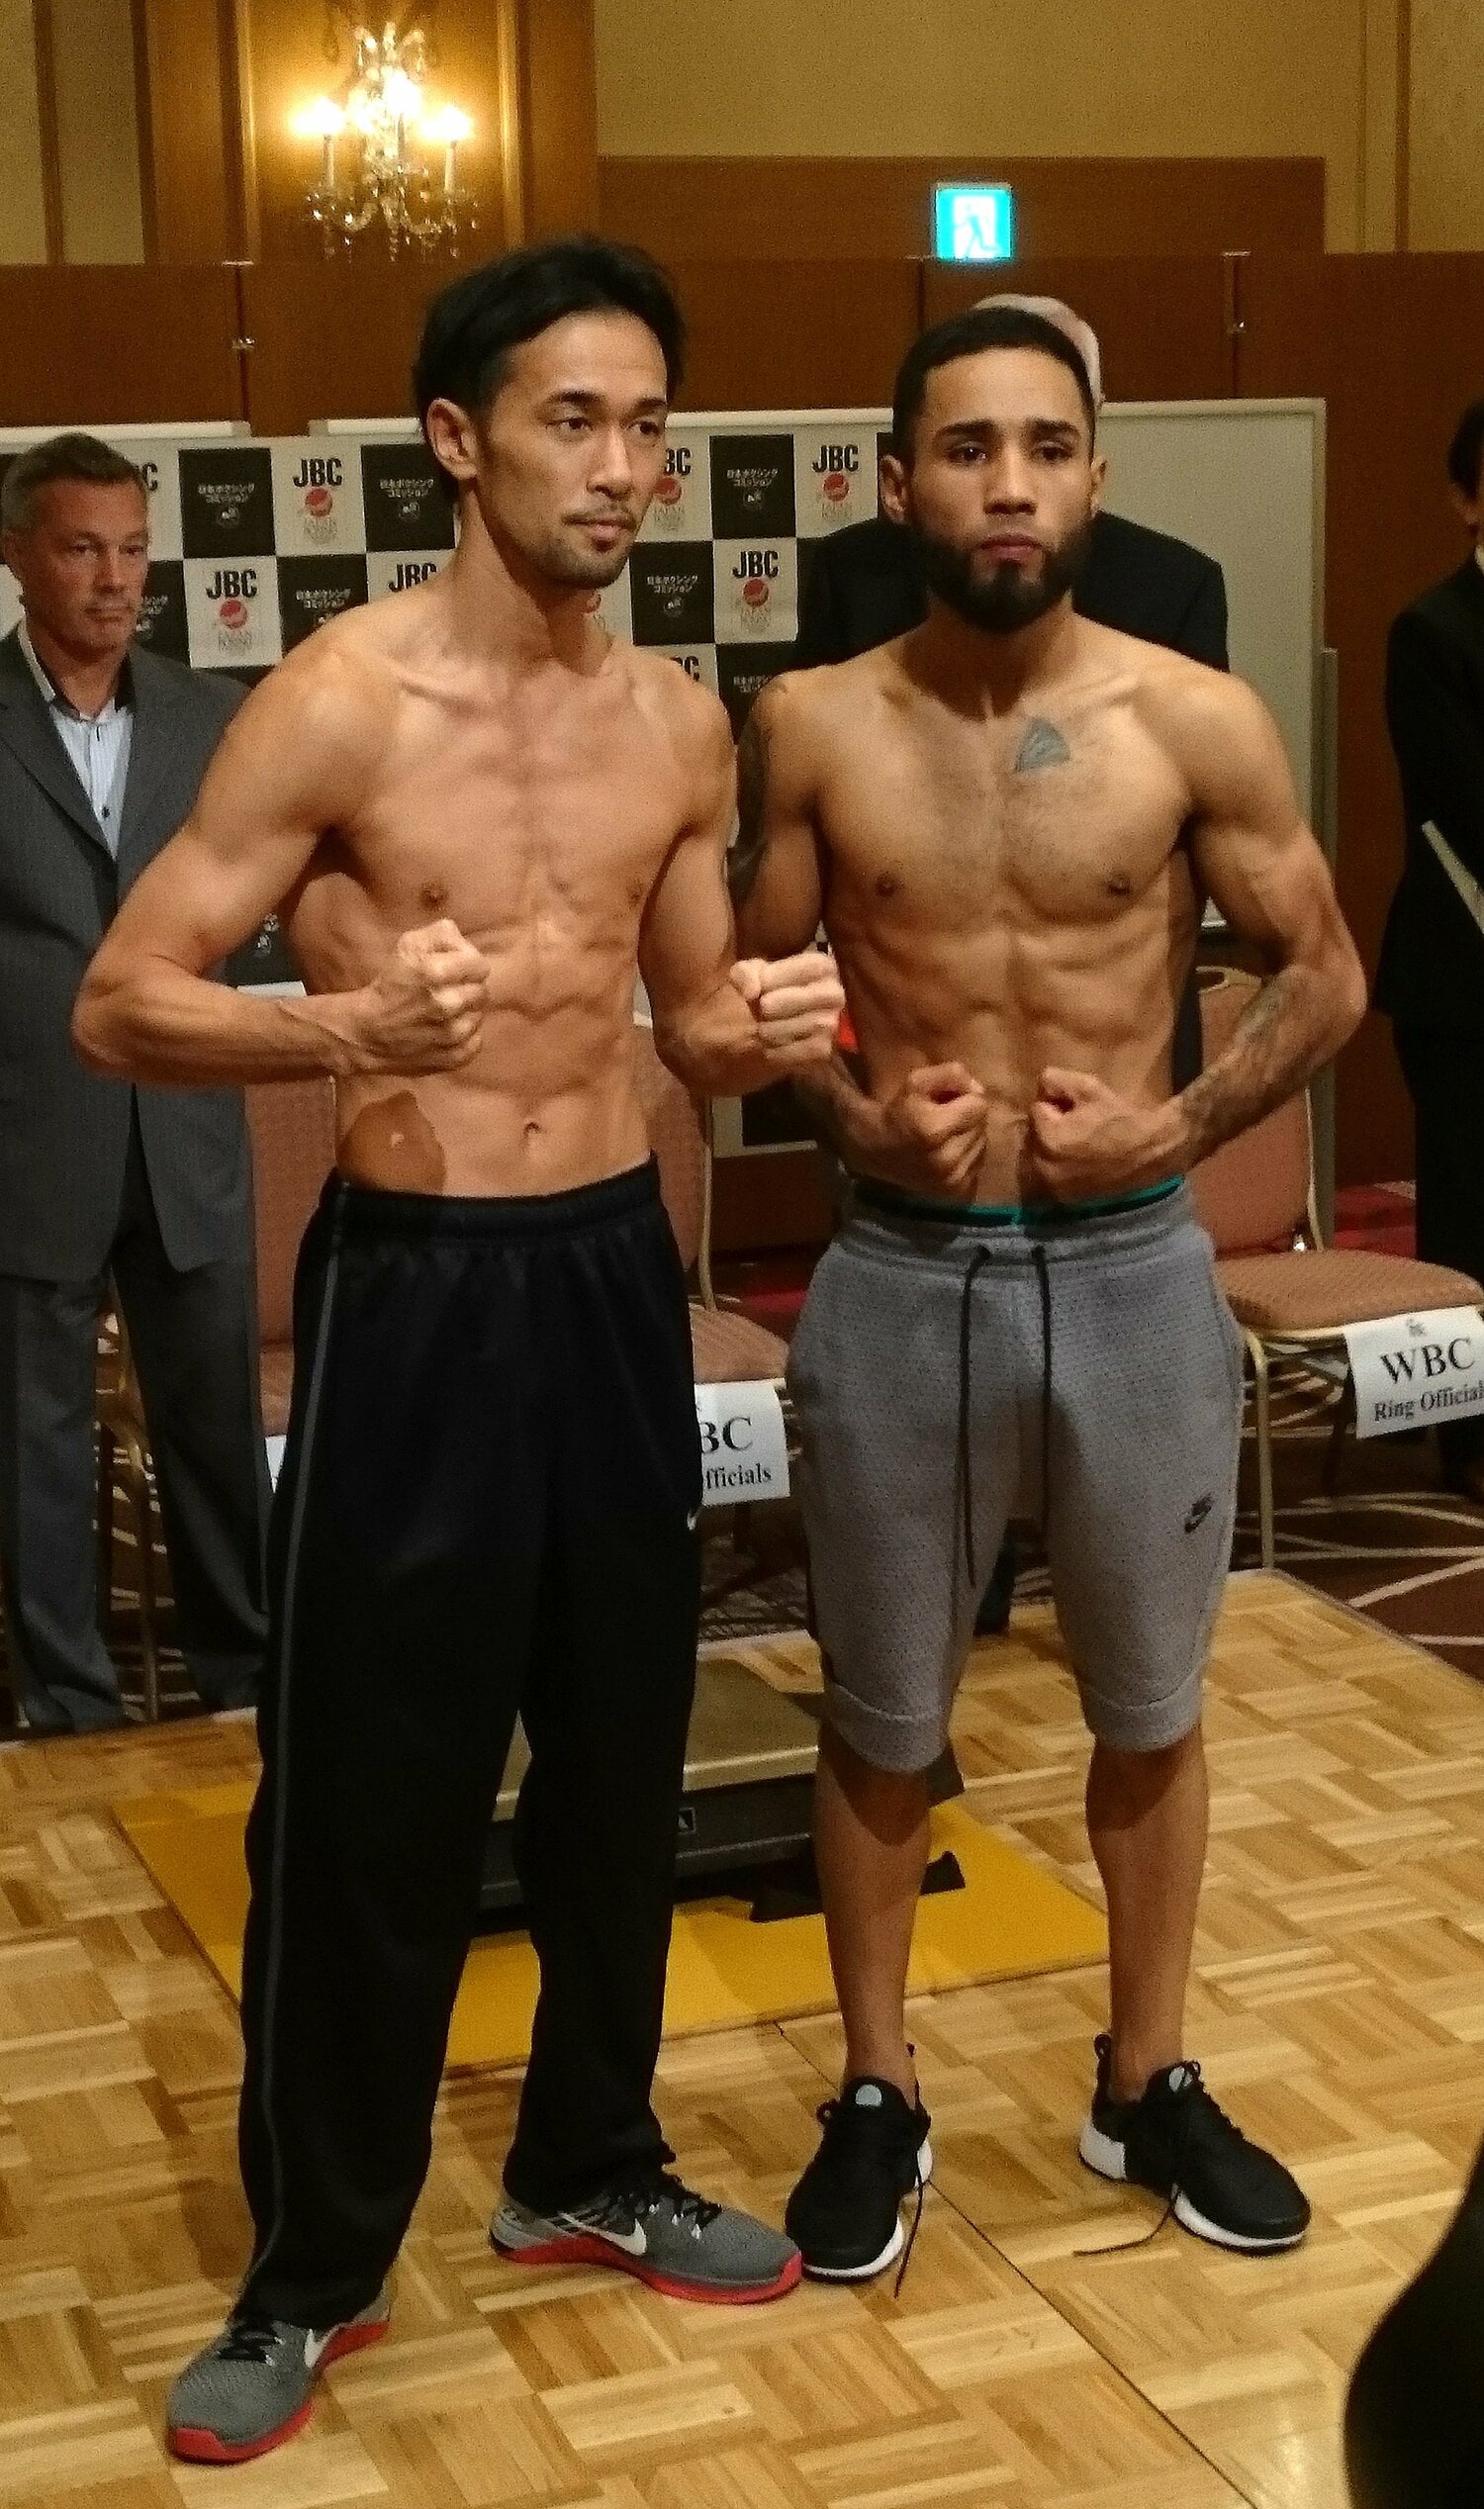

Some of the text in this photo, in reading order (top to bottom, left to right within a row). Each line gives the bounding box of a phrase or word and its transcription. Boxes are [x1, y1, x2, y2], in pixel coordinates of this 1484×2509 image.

[293, 458, 342, 487] JBC
[664, 447, 692, 476] BC
[812, 444, 859, 472] JBC
[732, 550, 779, 579] JBC
[206, 569, 257, 600] JBC
[1379, 1337, 1475, 1384] WBC
[1374, 1380, 1484, 1422] Ring Official
[698, 1416, 752, 1453] BC
[706, 1463, 773, 1489] fficials
